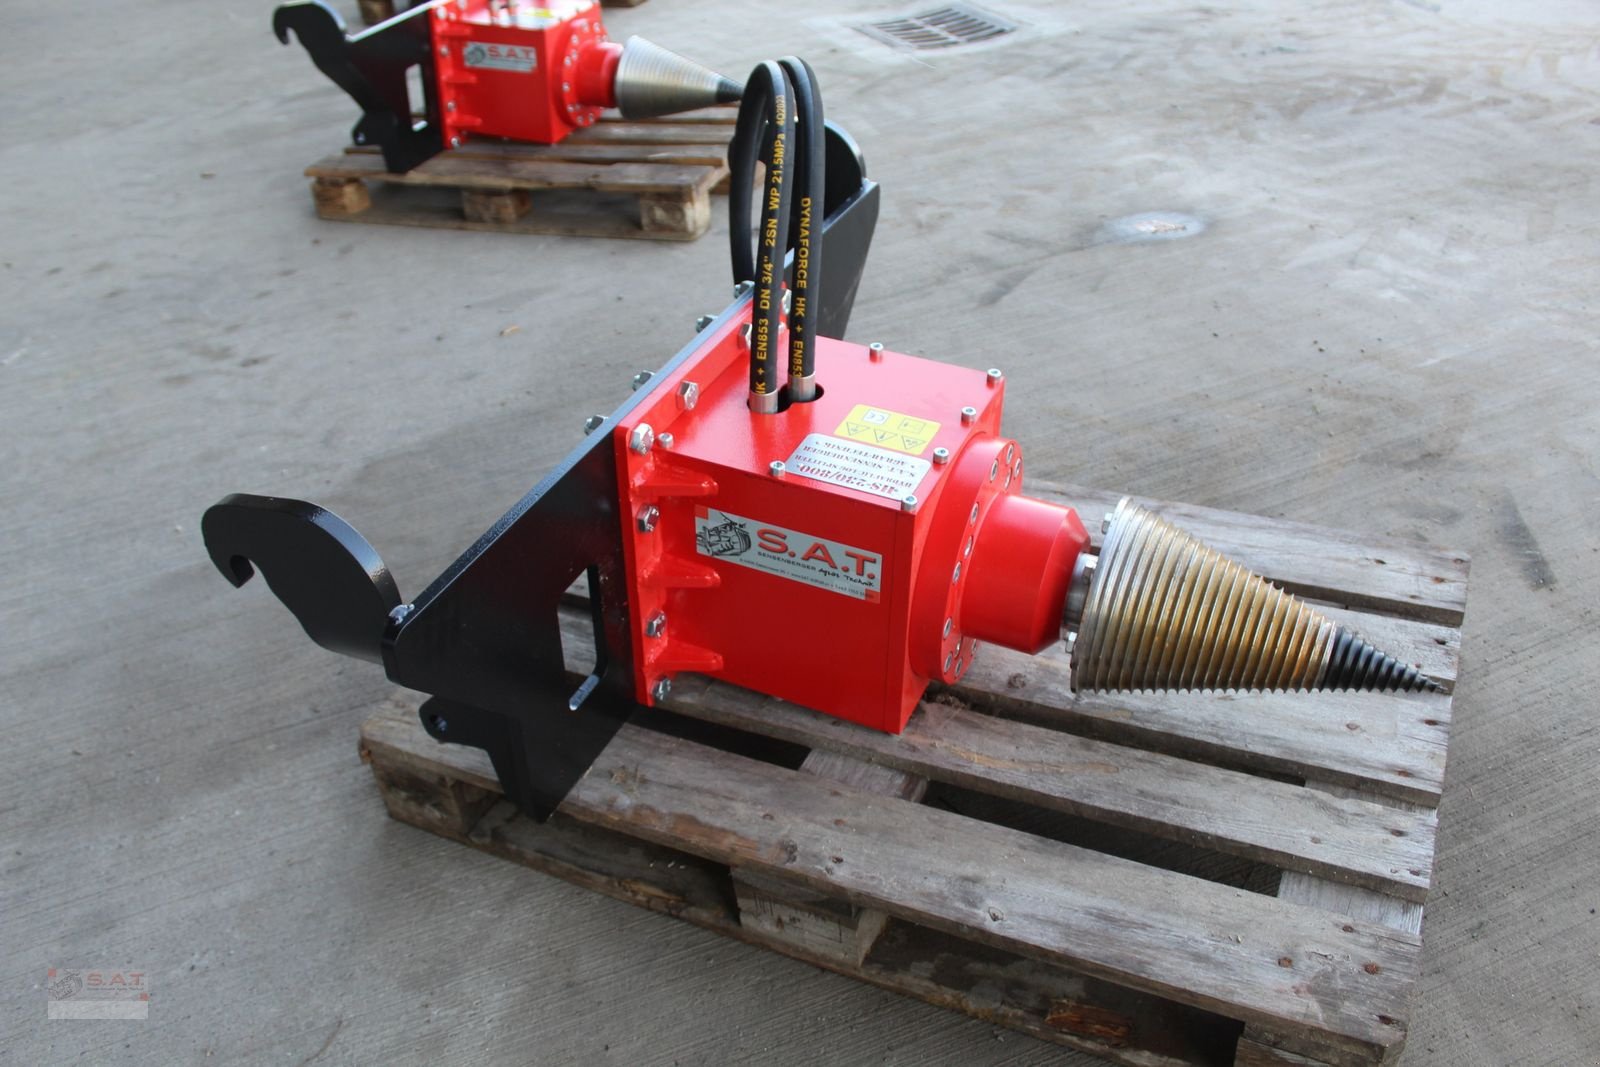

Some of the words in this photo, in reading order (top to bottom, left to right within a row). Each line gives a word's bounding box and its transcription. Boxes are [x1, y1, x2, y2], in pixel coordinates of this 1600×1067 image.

[772, 133, 786, 183] 21.5MPa
[768, 187, 781, 211] WP
[765, 219, 779, 247] 2SN
[797, 197, 811, 289] DYNAFORCE
[759, 289, 771, 310] DN
[795, 296, 806, 317] HK
[756, 319, 769, 360] EN853
[794, 454, 837, 470] SPLITTER
[757, 528, 877, 580] S.A.T.
